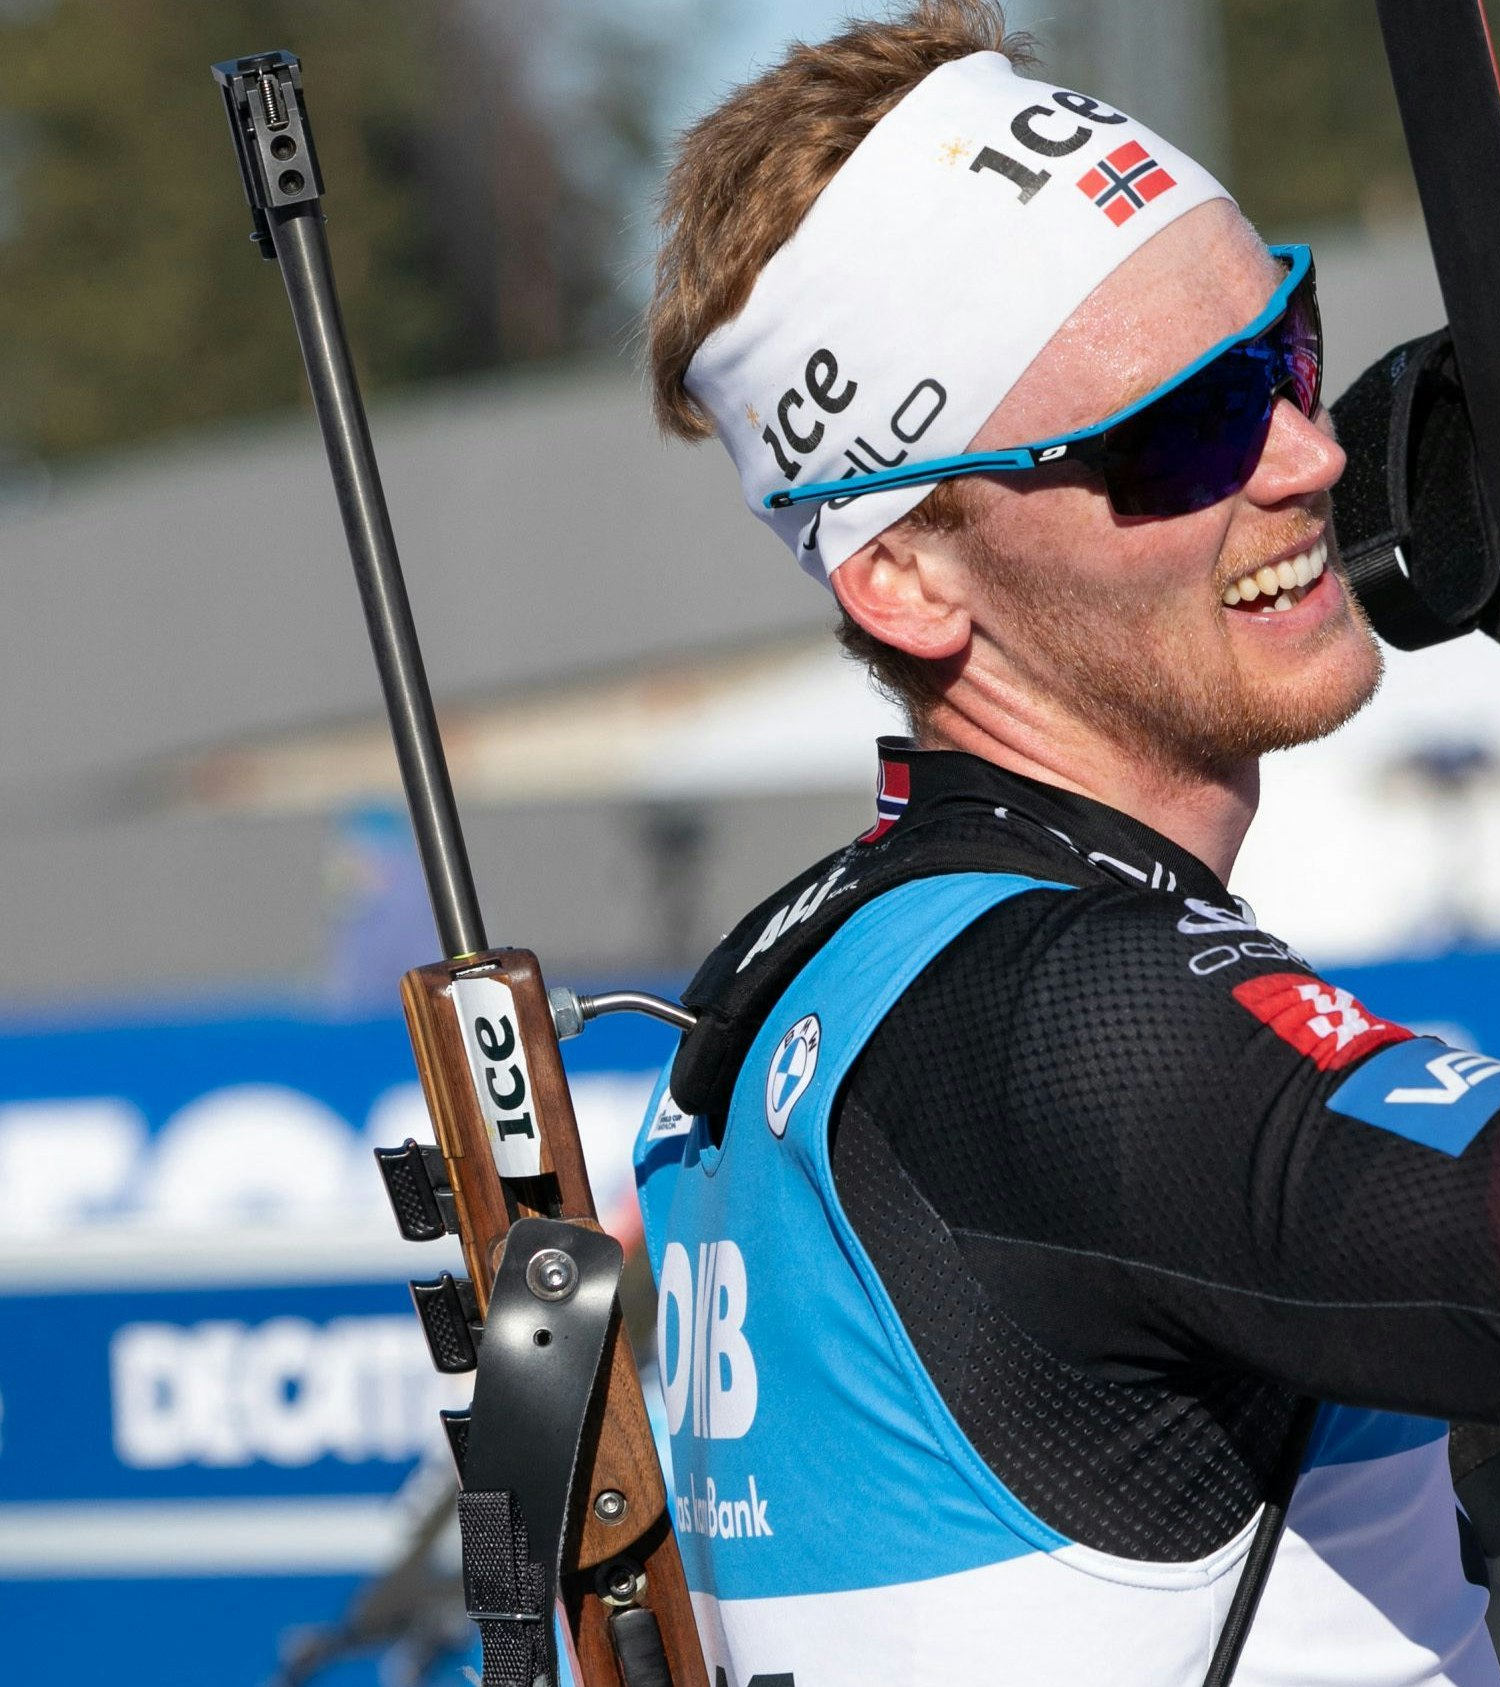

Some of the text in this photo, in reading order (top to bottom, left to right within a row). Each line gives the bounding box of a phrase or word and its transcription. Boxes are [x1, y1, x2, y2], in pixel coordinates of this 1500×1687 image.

[968, 91, 1129, 206] ice
[762, 348, 858, 482] ice
[475, 1015, 535, 1142] ice
[784, 1018, 818, 1052] BMW
[707, 1474, 774, 1539] Bank
